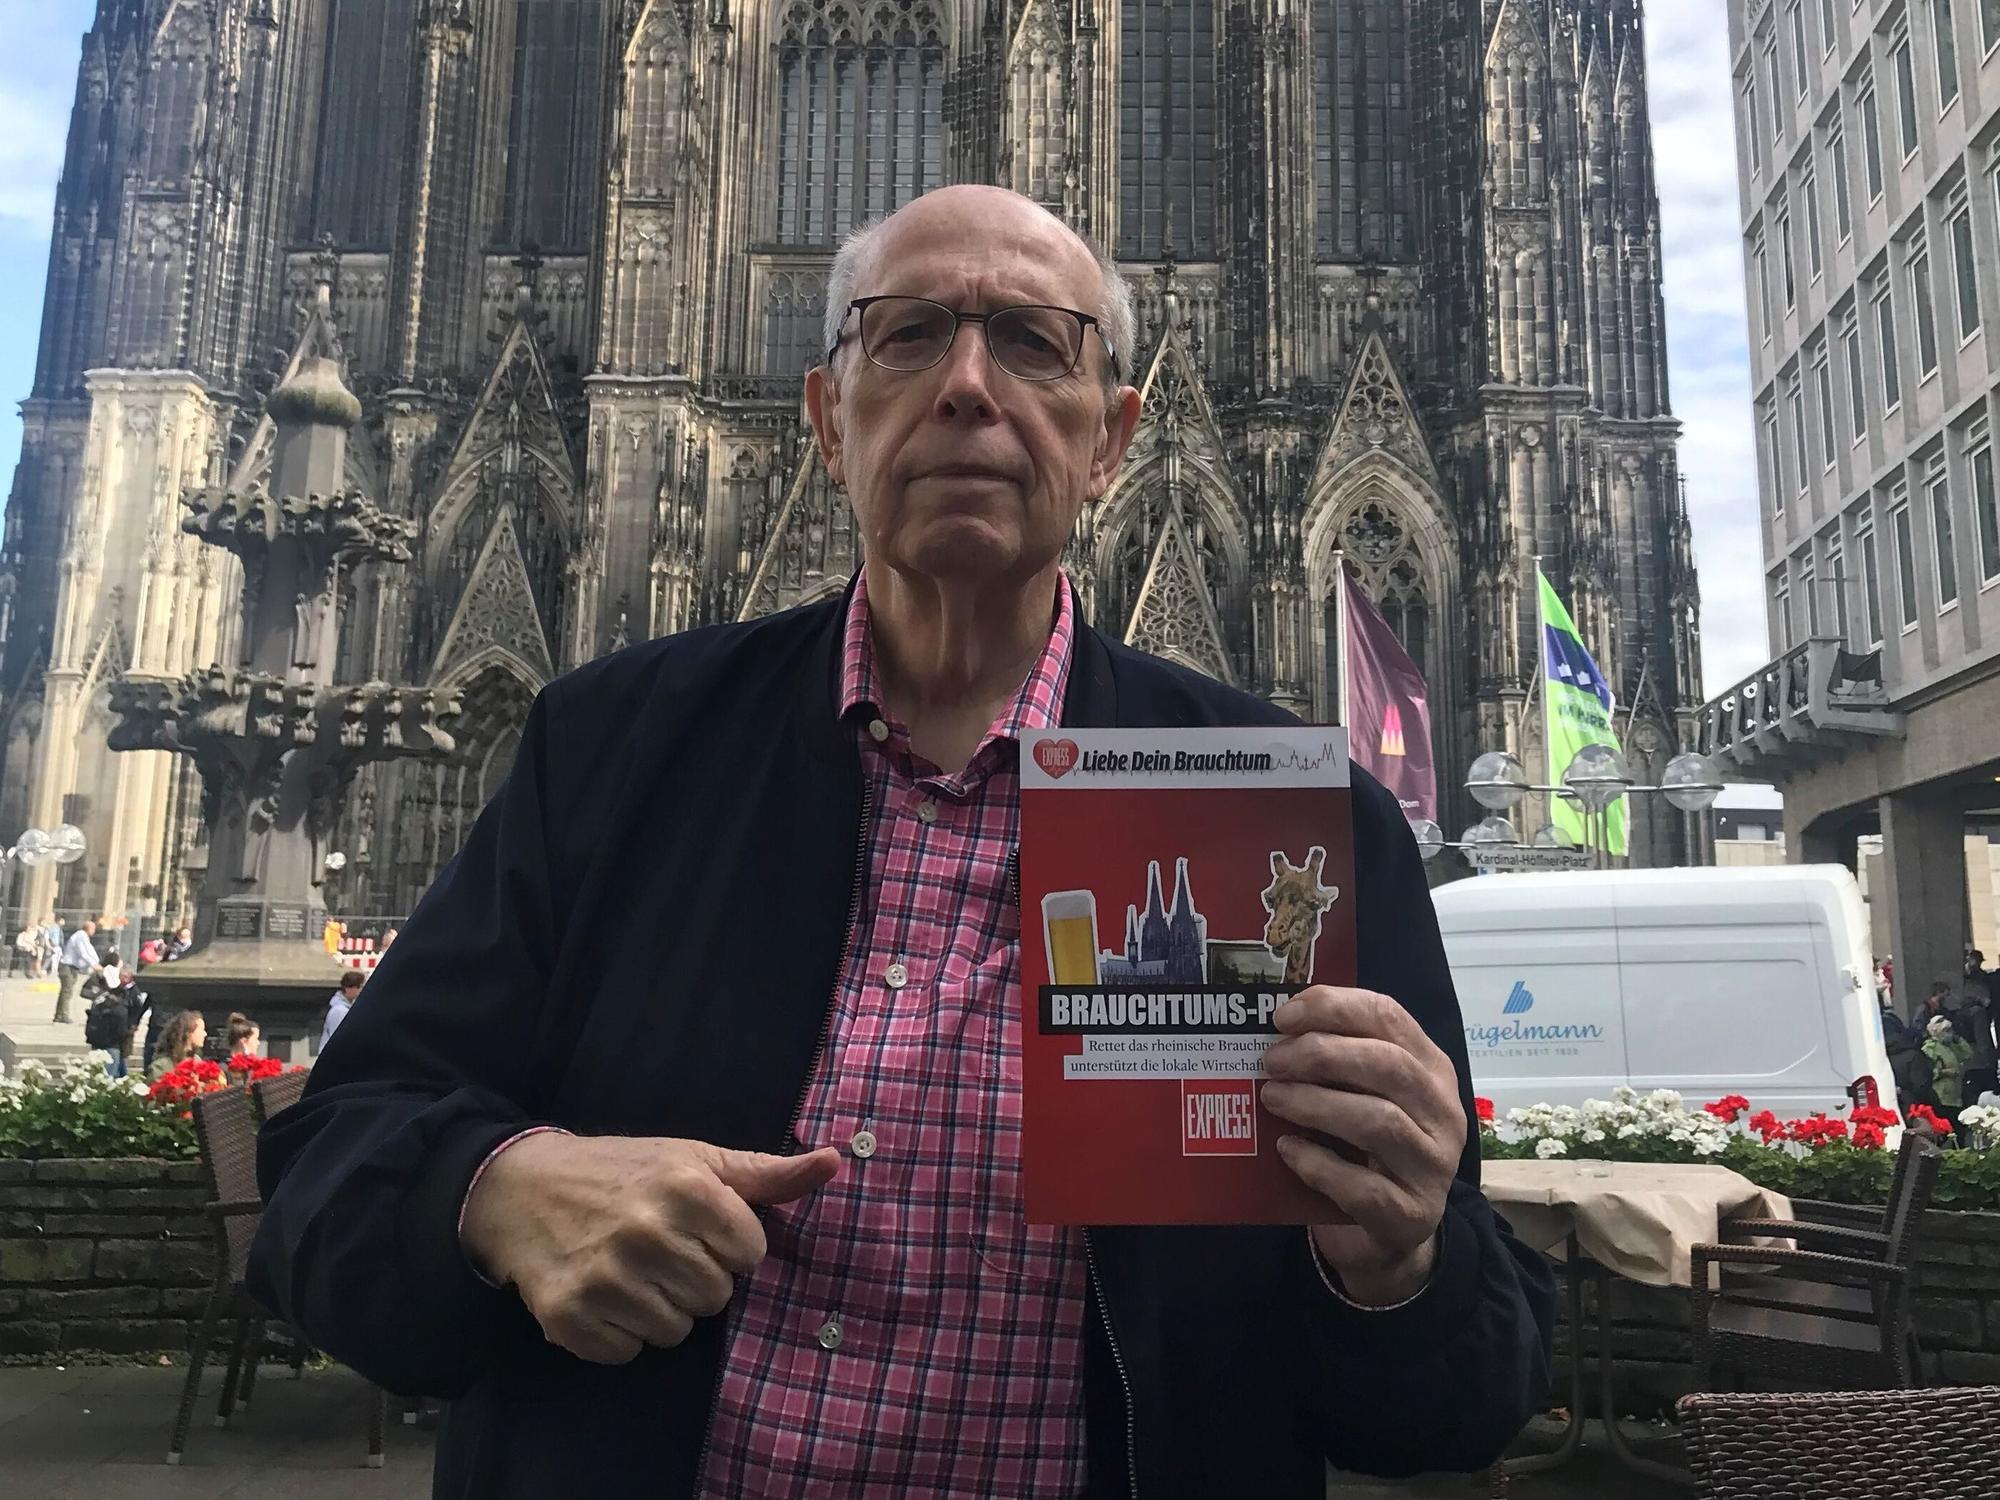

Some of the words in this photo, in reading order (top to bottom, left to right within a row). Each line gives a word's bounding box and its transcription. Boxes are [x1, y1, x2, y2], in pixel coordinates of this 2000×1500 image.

[1082, 749, 1128, 772] Liebe
[1131, 749, 1172, 772] Dein
[1174, 749, 1271, 772] Brauchtum
[1464, 1019, 1604, 1048] rügelmann
[1089, 1039, 1126, 1052] Rettet
[1128, 1039, 1149, 1052] das
[1151, 1039, 1215, 1052] rheinische
[1071, 1059, 1137, 1072] unterstützt
[1140, 1059, 1159, 1072] die
[1162, 1059, 1198, 1072] lokale
[1186, 1093, 1251, 1139] EXPRESS
